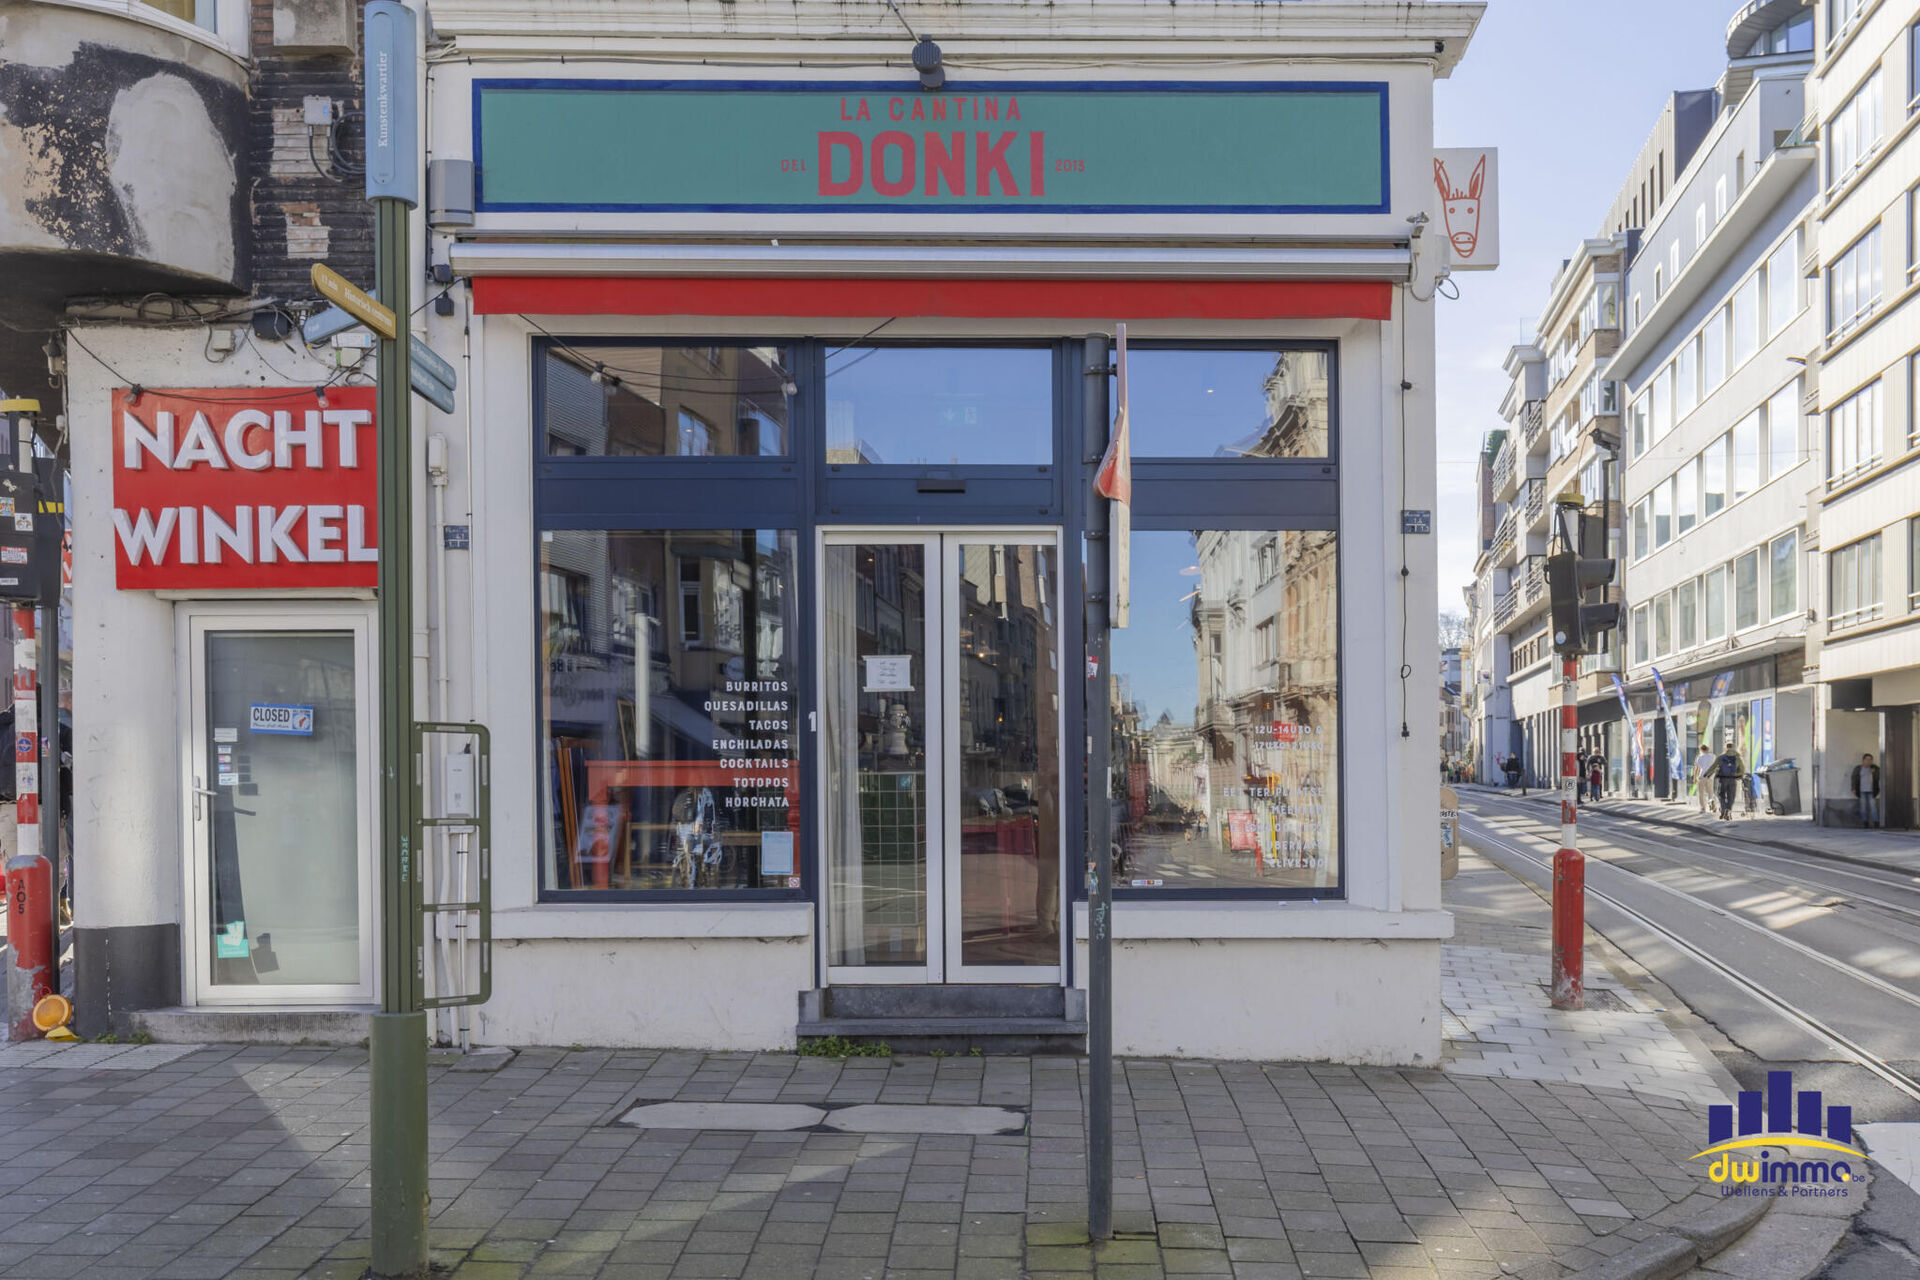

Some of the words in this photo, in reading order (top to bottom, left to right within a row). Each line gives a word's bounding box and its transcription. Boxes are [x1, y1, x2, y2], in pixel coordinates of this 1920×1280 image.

[376, 51, 388, 148] Kunstenkwartier
[840, 97, 871, 122] LA
[888, 97, 1022, 122] CANTINA
[781, 159, 807, 172] DEL
[817, 130, 1046, 197] DONKI
[123, 409, 372, 471] NACHT
[113, 505, 378, 567] WINKEL
[725, 681, 789, 692] BURRITOS
[703, 700, 789, 712] QUESADILLAS
[253, 707, 290, 722] CLOSED
[748, 719, 789, 731] TACOS
[712, 738, 789, 750] ENCHILADAS
[719, 757, 789, 769] COCKTAILS
[733, 777, 789, 788] TOTOPOS
[1249, 787, 1271, 797] TER
[725, 796, 790, 808] HORCHATA
